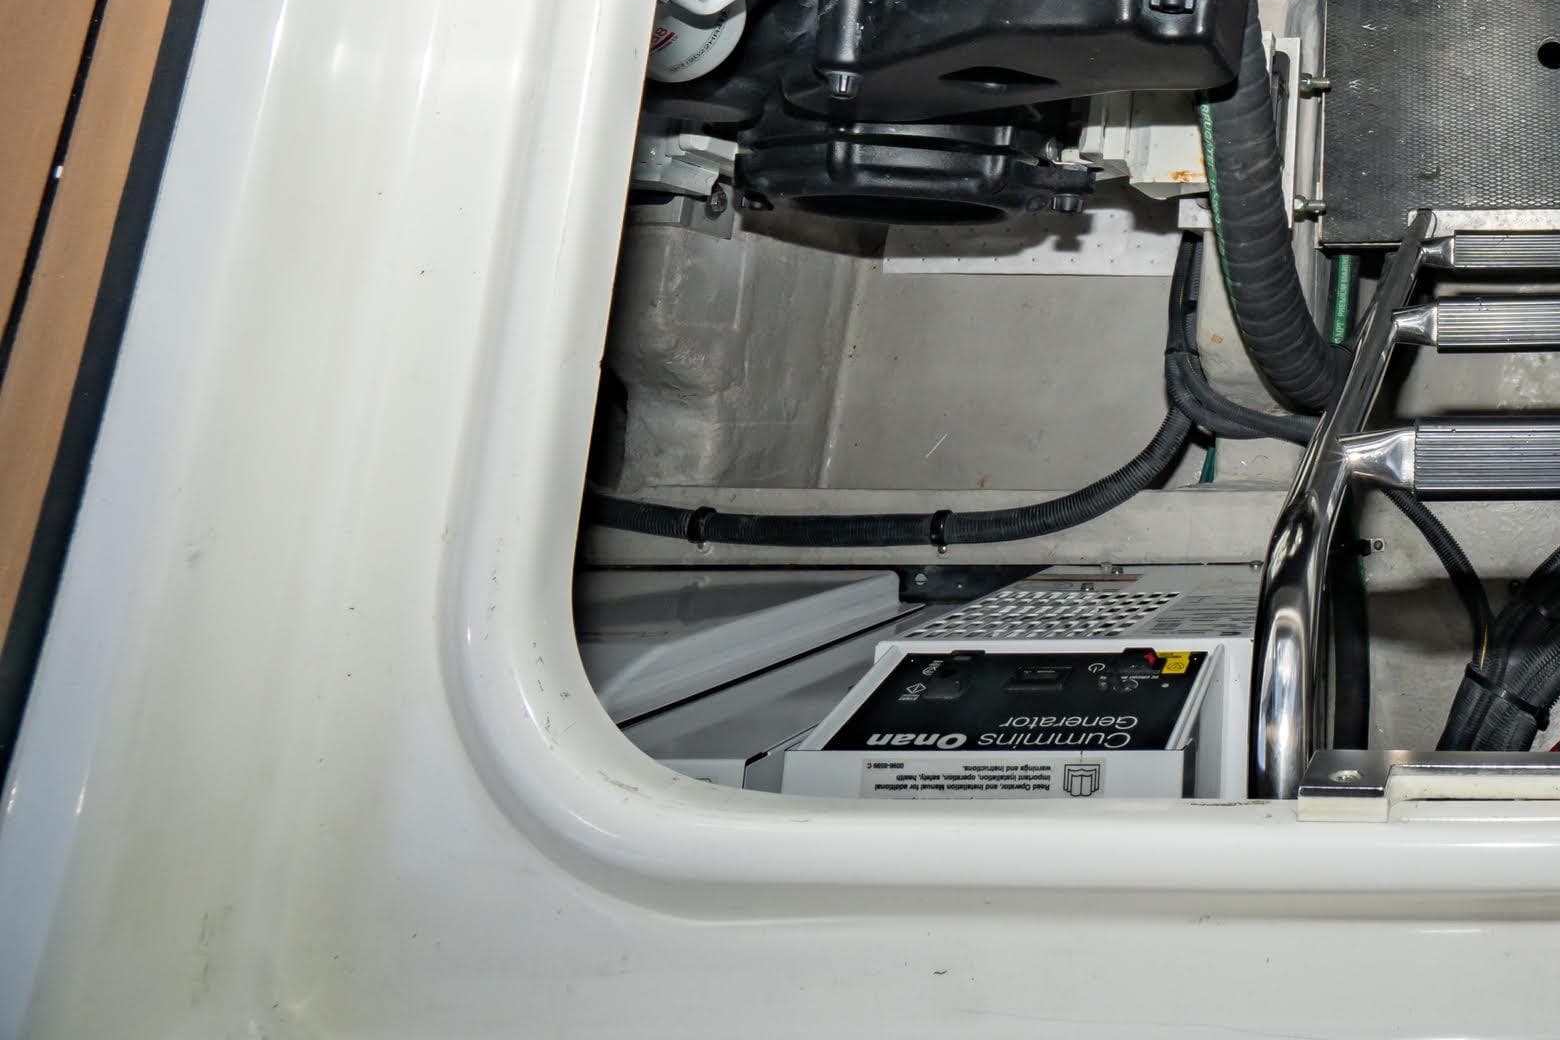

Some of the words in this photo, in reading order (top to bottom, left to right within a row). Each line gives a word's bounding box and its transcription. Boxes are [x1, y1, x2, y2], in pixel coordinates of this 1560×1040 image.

[999, 715, 1139, 729] Generator
[865, 732, 969, 750] Onan
[978, 732, 1132, 749] Cummins
[1020, 764, 1051, 772] warnings
[896, 774, 917, 782] health
[977, 773, 1016, 782] installation,
[1018, 773, 1050, 782] important
